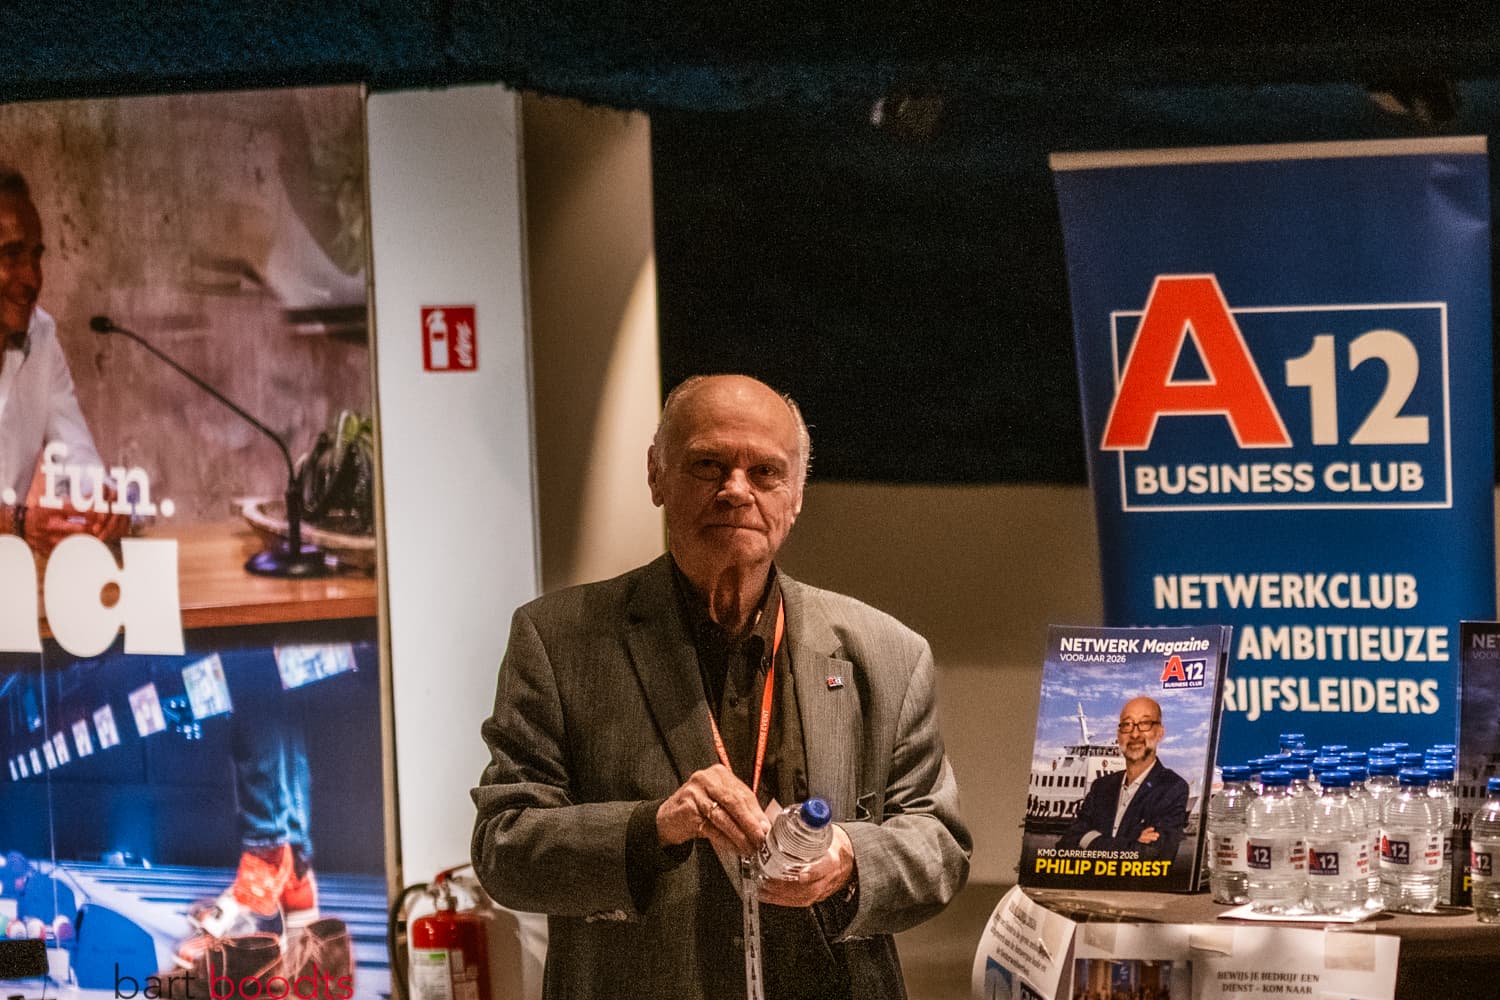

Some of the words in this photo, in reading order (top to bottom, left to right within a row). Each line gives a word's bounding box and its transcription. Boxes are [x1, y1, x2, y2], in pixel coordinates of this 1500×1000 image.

[1100, 273, 1430, 451] A12
[40, 441, 175, 517] fun.
[1135, 463, 1314, 494] BUSINESS
[1324, 462, 1424, 492] CLUB
[1153, 573, 1418, 609] NETWERKCLUB
[1060, 637, 1139, 653] NETWERK
[1142, 637, 1209, 656] Magazine
[1060, 653, 1105, 663] VOORJAAR
[1106, 654, 1126, 663] 2026
[1238, 626, 1449, 661] AMBITIEUZE
[1160, 655, 1204, 682] A12
[1222, 677, 1440, 721] RIJFSLEIDERS
[1035, 858, 1091, 875] PHILIP
[1094, 861, 1117, 876] DE
[1120, 861, 1171, 877] PREST
[1222, 983, 1253, 993] DIENST
[1262, 984, 1283, 993] KOM
[1286, 985, 1312, 994] NAAR
